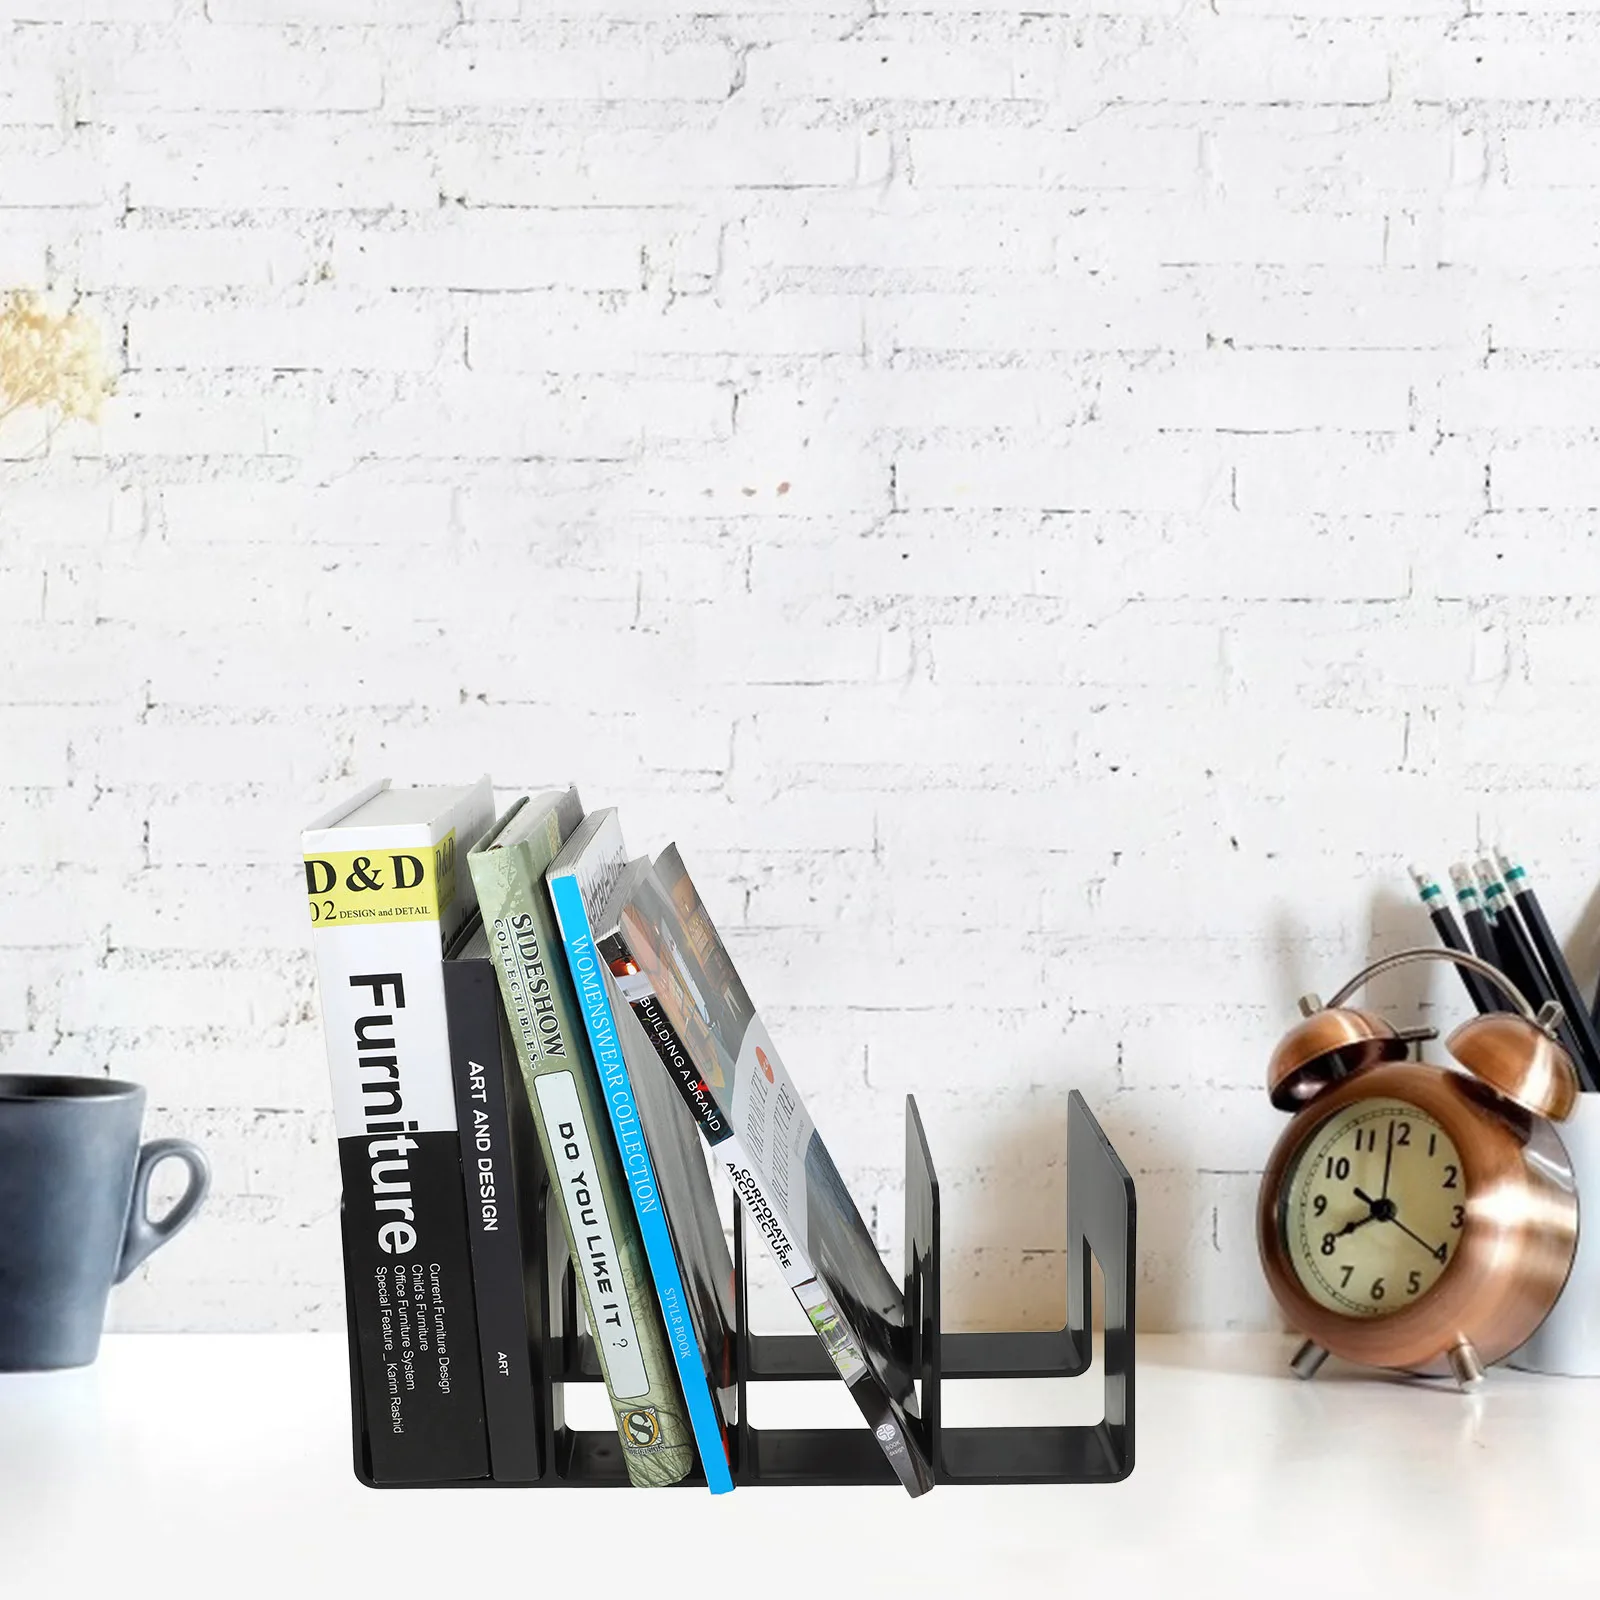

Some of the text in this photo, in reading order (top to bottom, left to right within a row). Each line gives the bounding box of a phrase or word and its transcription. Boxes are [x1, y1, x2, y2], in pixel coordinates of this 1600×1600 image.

[304, 855, 425, 894] D & D
[339, 909, 376, 919] DESIGN
[378, 907, 393, 917] and
[395, 906, 430, 916] DETAIL
[512, 913, 566, 1057] SIDESHOW
[571, 934, 623, 1089] WOMENSWEAR
[612, 1091, 658, 1213] COLLECTION
[639, 996, 721, 1132] BUILDING A BRAND
[349, 972, 419, 1255] Furniture
[468, 1060, 498, 1231] ART AND DESIGN
[1355, 1128, 1375, 1152] 11
[1428, 1133, 1436, 1157] 1
[1326, 1157, 1349, 1180] 10
[1442, 1165, 1457, 1188] 2
[726, 1162, 791, 1268] ARCHITECTURE
[740, 1168, 792, 1253] CORPORATE
[1313, 1195, 1327, 1216] 9
[1451, 1205, 1465, 1228] 3
[558, 1122, 629, 1348] DO YOU LIKE IT ?
[1320, 1233, 1336, 1256] 8
[1434, 1242, 1448, 1264] 4
[375, 1266, 388, 1306] Special
[1340, 1266, 1354, 1288] 7
[1371, 1278, 1385, 1300] 6
[1406, 1271, 1421, 1294] 5
[411, 1263, 428, 1351] Child's Furniture
[664, 1287, 691, 1359] STYLR BOOK
[381, 1309, 393, 1350] Feature
[394, 1265, 415, 1390] Office Furniture System
[429, 1263, 450, 1394] Current Furniture Design
[387, 1363, 398, 1394] Karim
[498, 1352, 509, 1376] ART
[391, 1397, 404, 1433] Rashid
